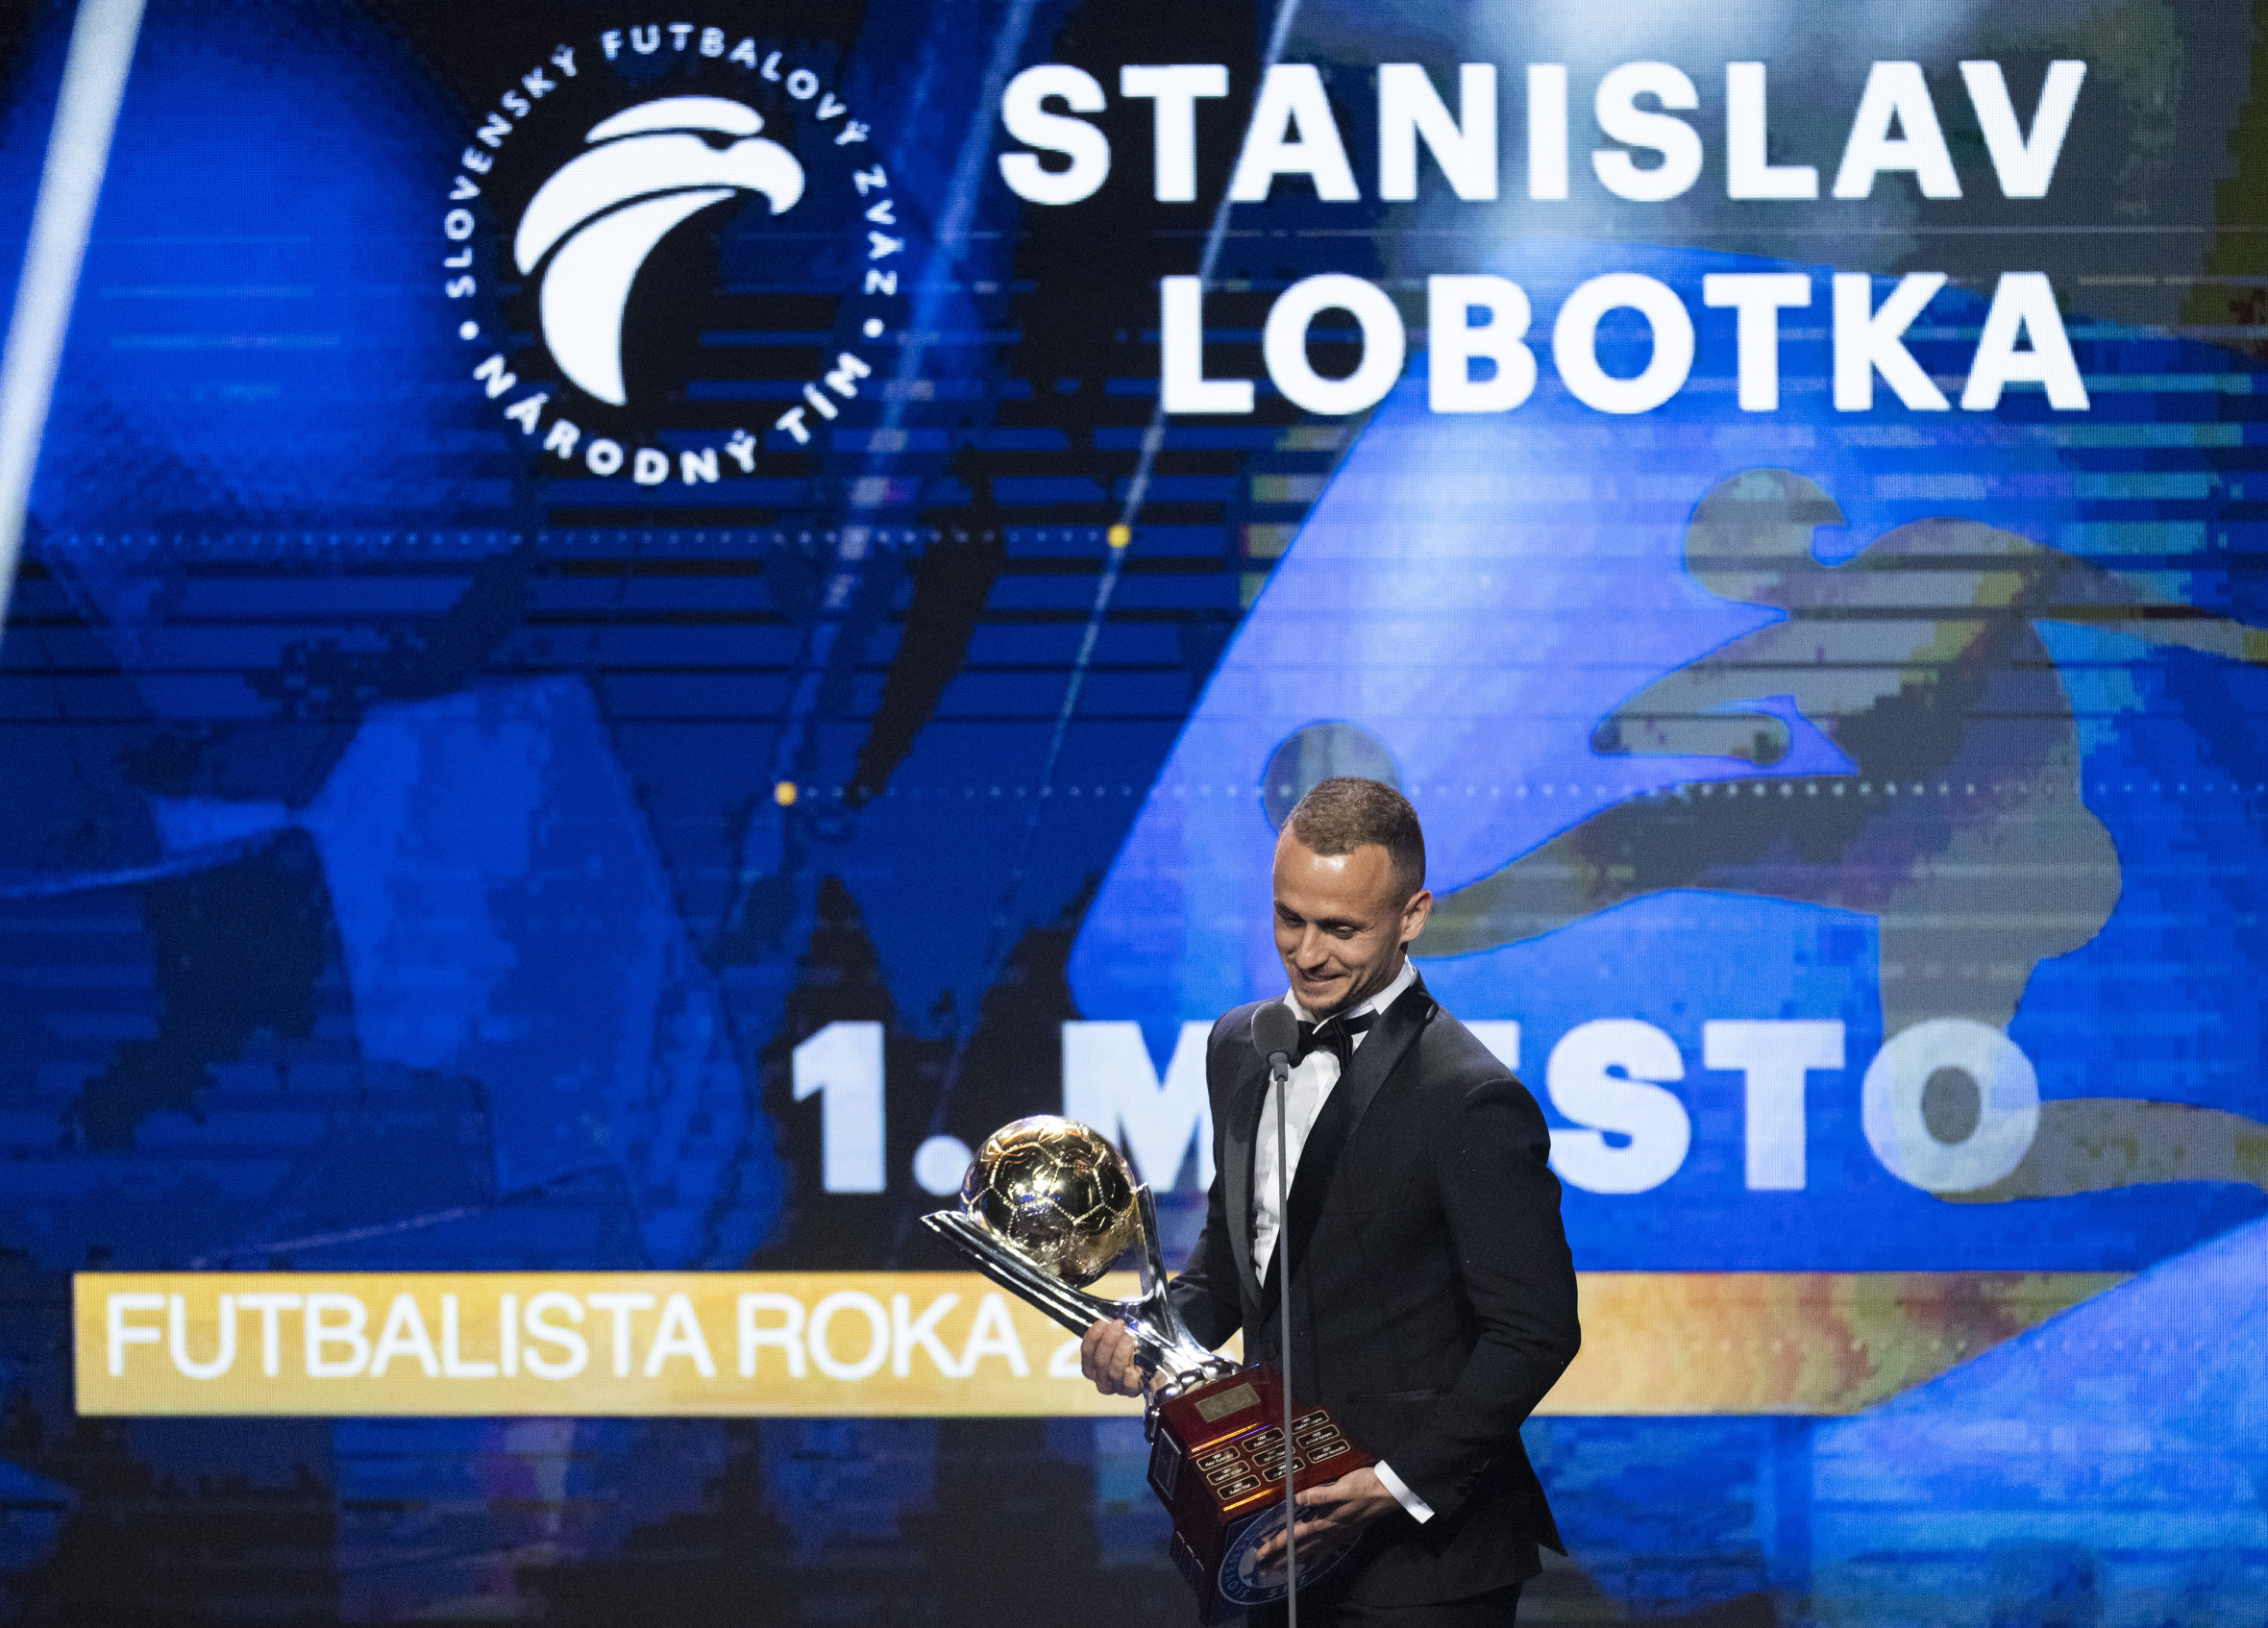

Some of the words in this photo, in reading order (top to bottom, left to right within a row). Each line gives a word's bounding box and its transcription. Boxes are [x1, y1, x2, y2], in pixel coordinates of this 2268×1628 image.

[444, 43, 579, 299] SLOVENSKÝ
[600, 21, 870, 146] FUTBALOVÝ
[998, 60, 2086, 205] STANISLAV
[1161, 271, 2089, 415] LOBOTKA
[473, 354, 757, 486] NÁRODNÝ
[775, 352, 872, 446] TÍM
[792, 1020, 973, 1197] 1.
[1061, 1018, 2039, 1195] MSTO
[107, 1292, 717, 1381] FUTBALISTA
[737, 1291, 1030, 1381] ROKA
